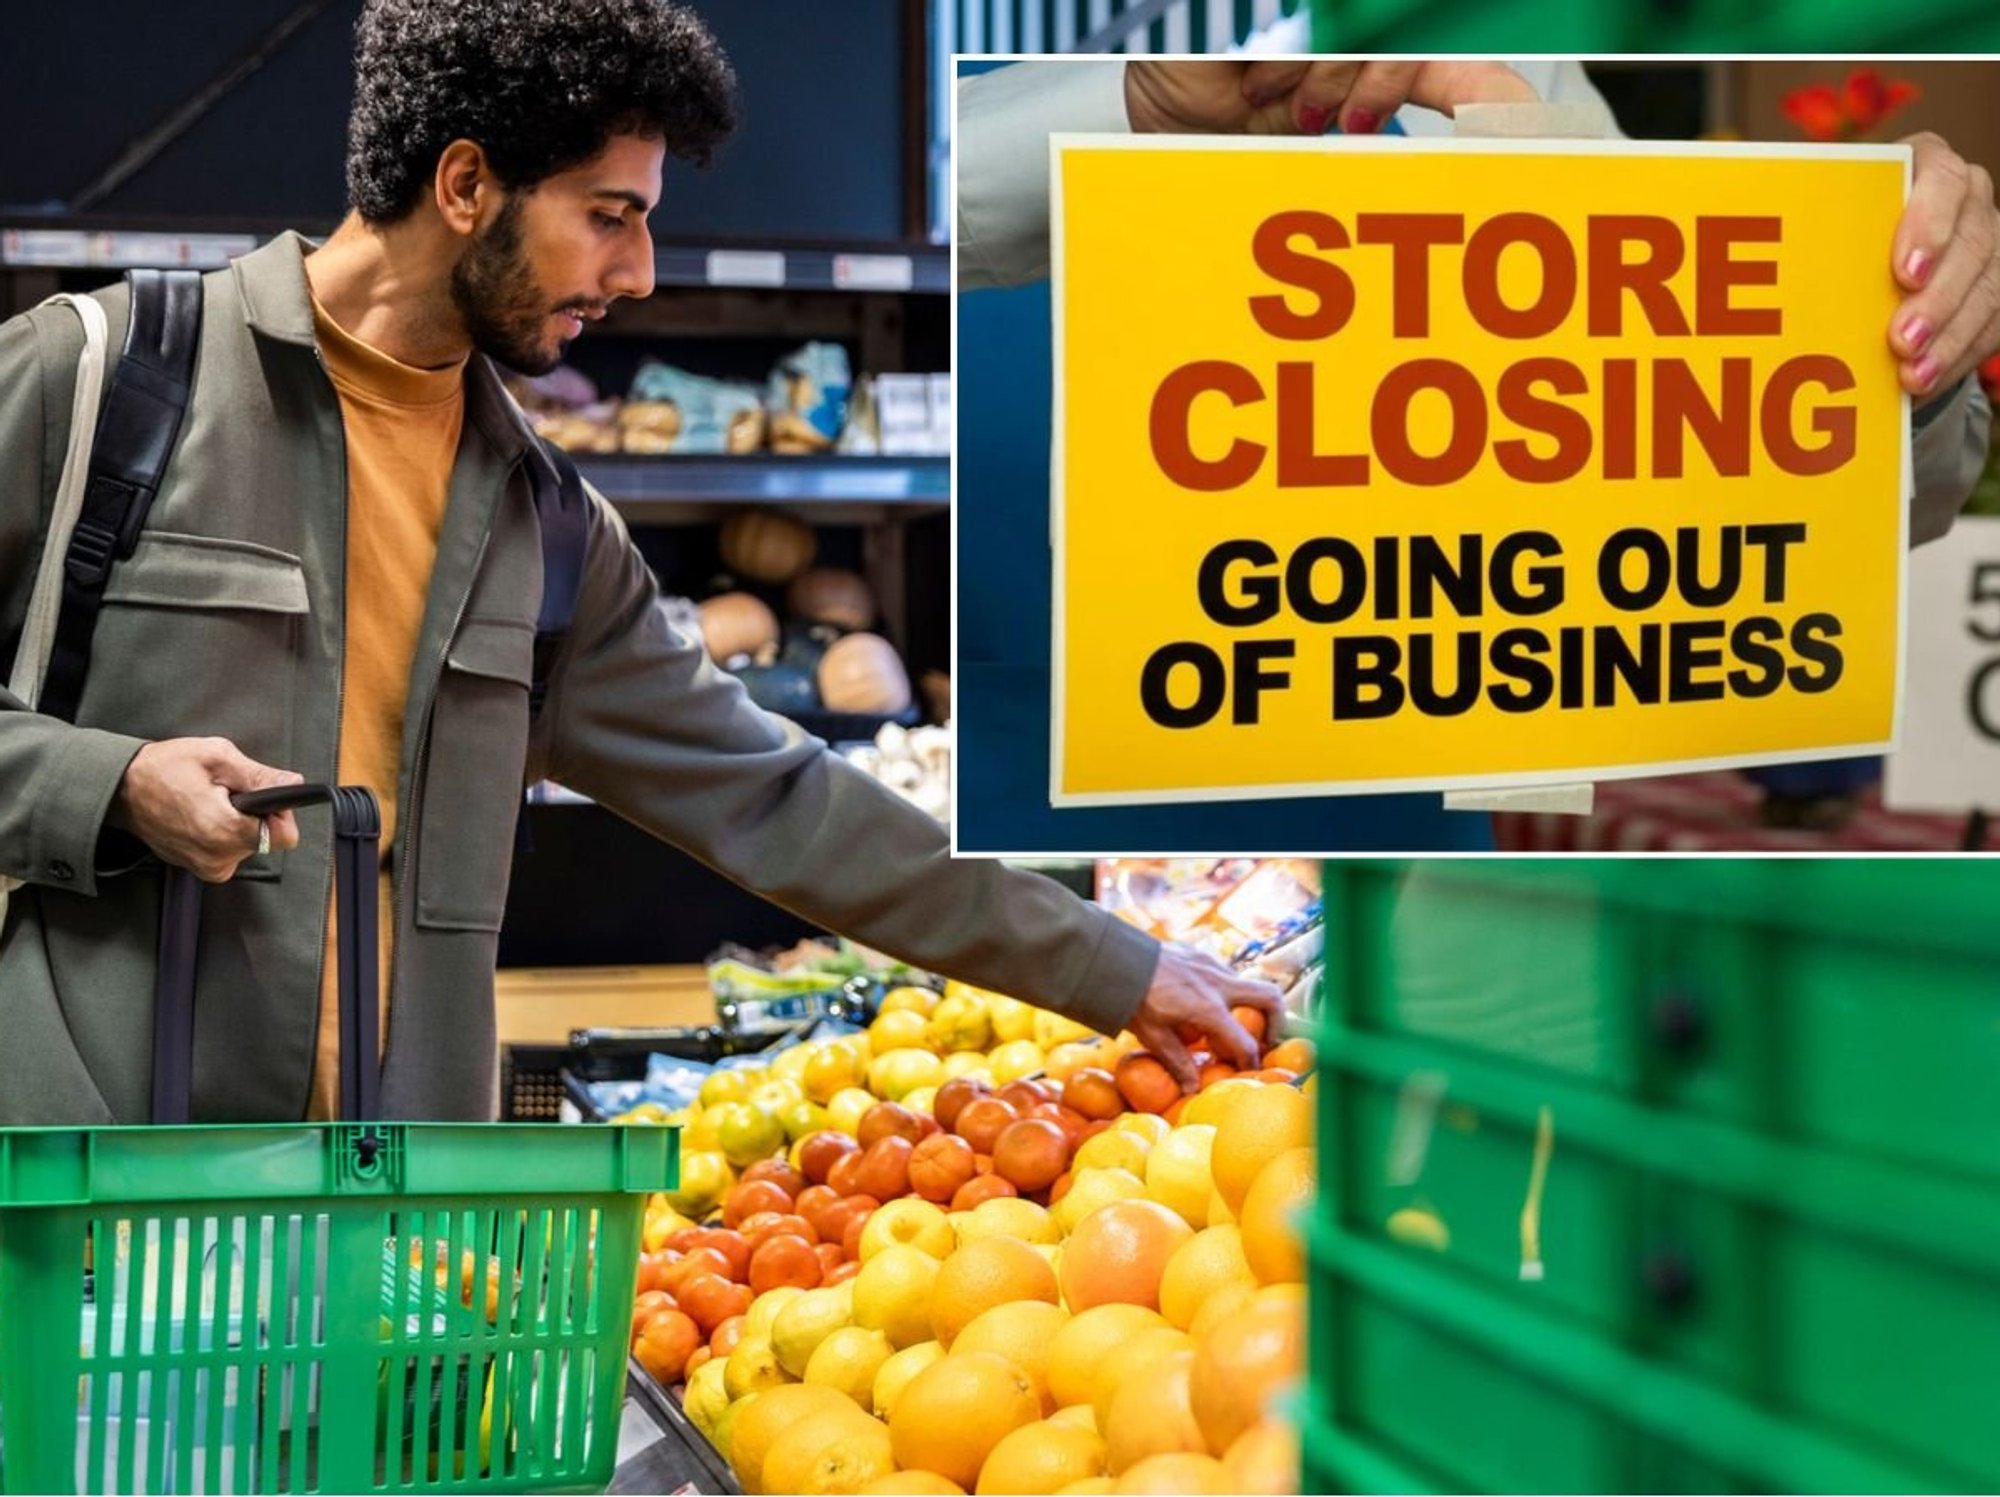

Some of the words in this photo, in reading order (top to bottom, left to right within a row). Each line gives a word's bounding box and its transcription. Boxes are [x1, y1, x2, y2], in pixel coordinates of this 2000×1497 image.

[1249, 210, 1783, 341] STORE
[1149, 354, 1858, 492] CLOSING
[1197, 527, 1566, 628] GOING
[1597, 523, 1807, 612] OUT
[1139, 638, 1297, 730] OF
[1332, 613, 1845, 722] BUSINESS
